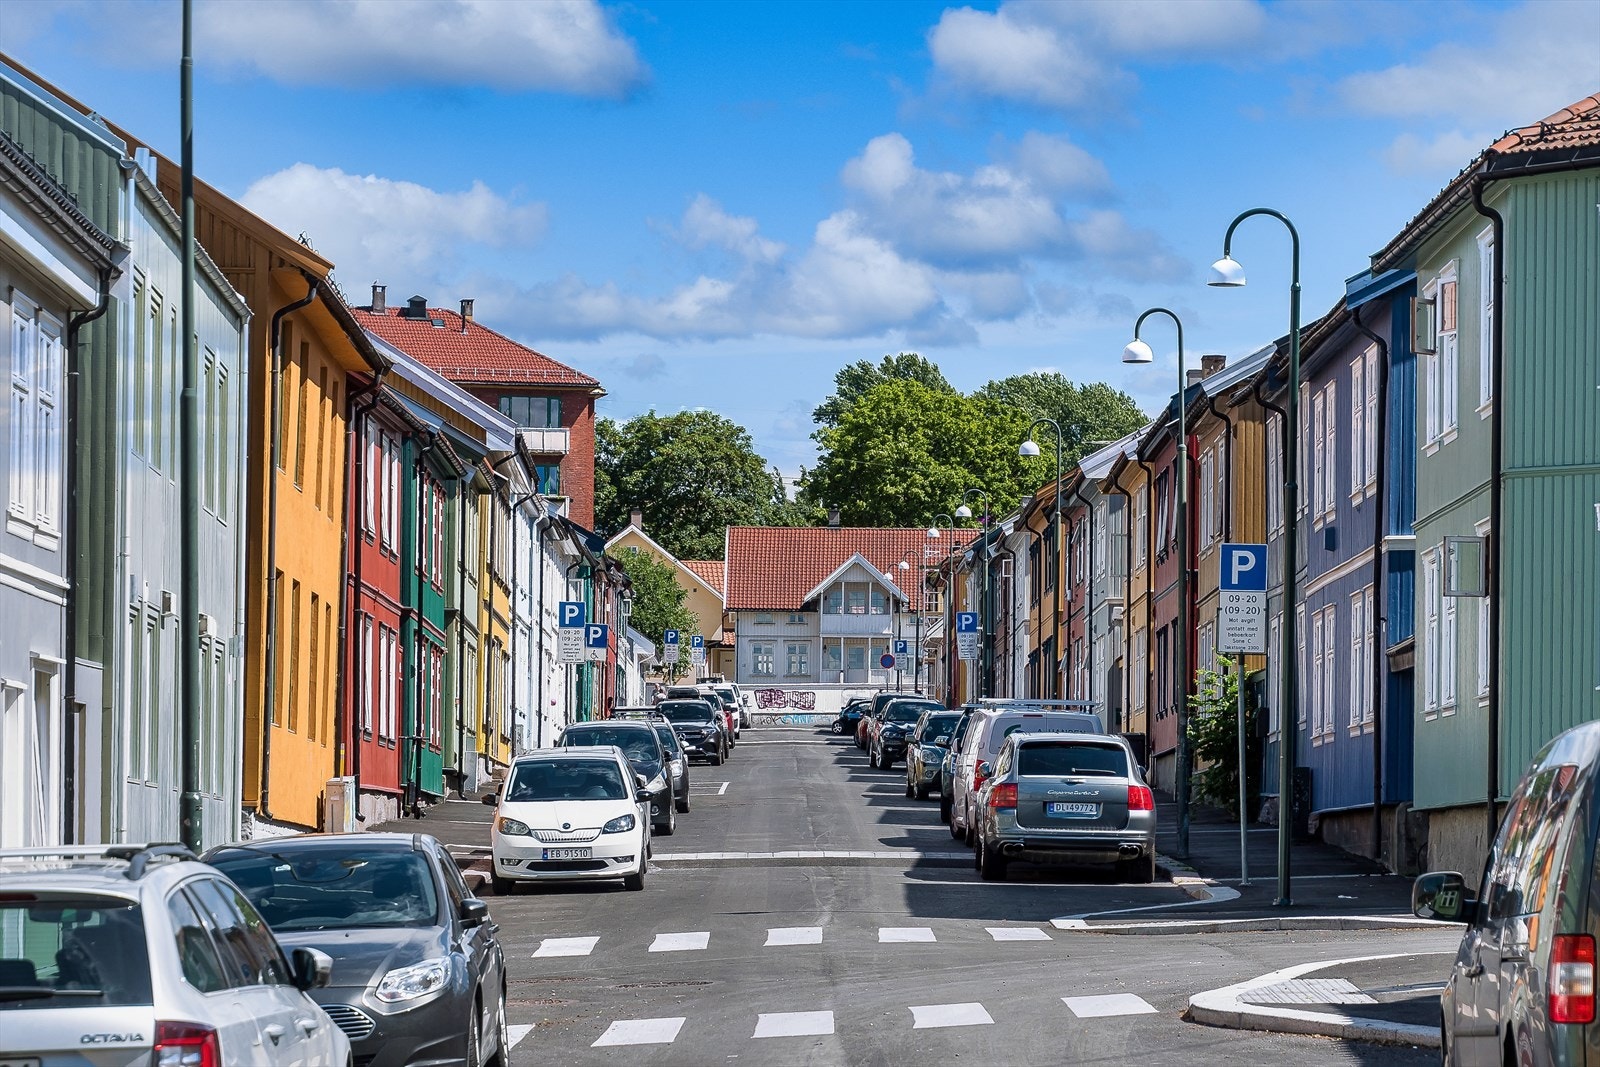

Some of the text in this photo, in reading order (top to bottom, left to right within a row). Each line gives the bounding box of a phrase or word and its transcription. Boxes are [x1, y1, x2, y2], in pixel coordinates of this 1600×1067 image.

[1232, 550, 1256, 585] P
[565, 604, 579, 625] P
[962, 614, 973, 630] P
[589, 626, 602, 645] P
[667, 631, 676, 643] P
[694, 637, 702, 646] P
[897, 641, 905, 652] P
[1056, 803, 1094, 812] DL 49772
[550, 849, 588, 858] EB 91510
[80, 1032, 145, 1044] OCTAVIA
